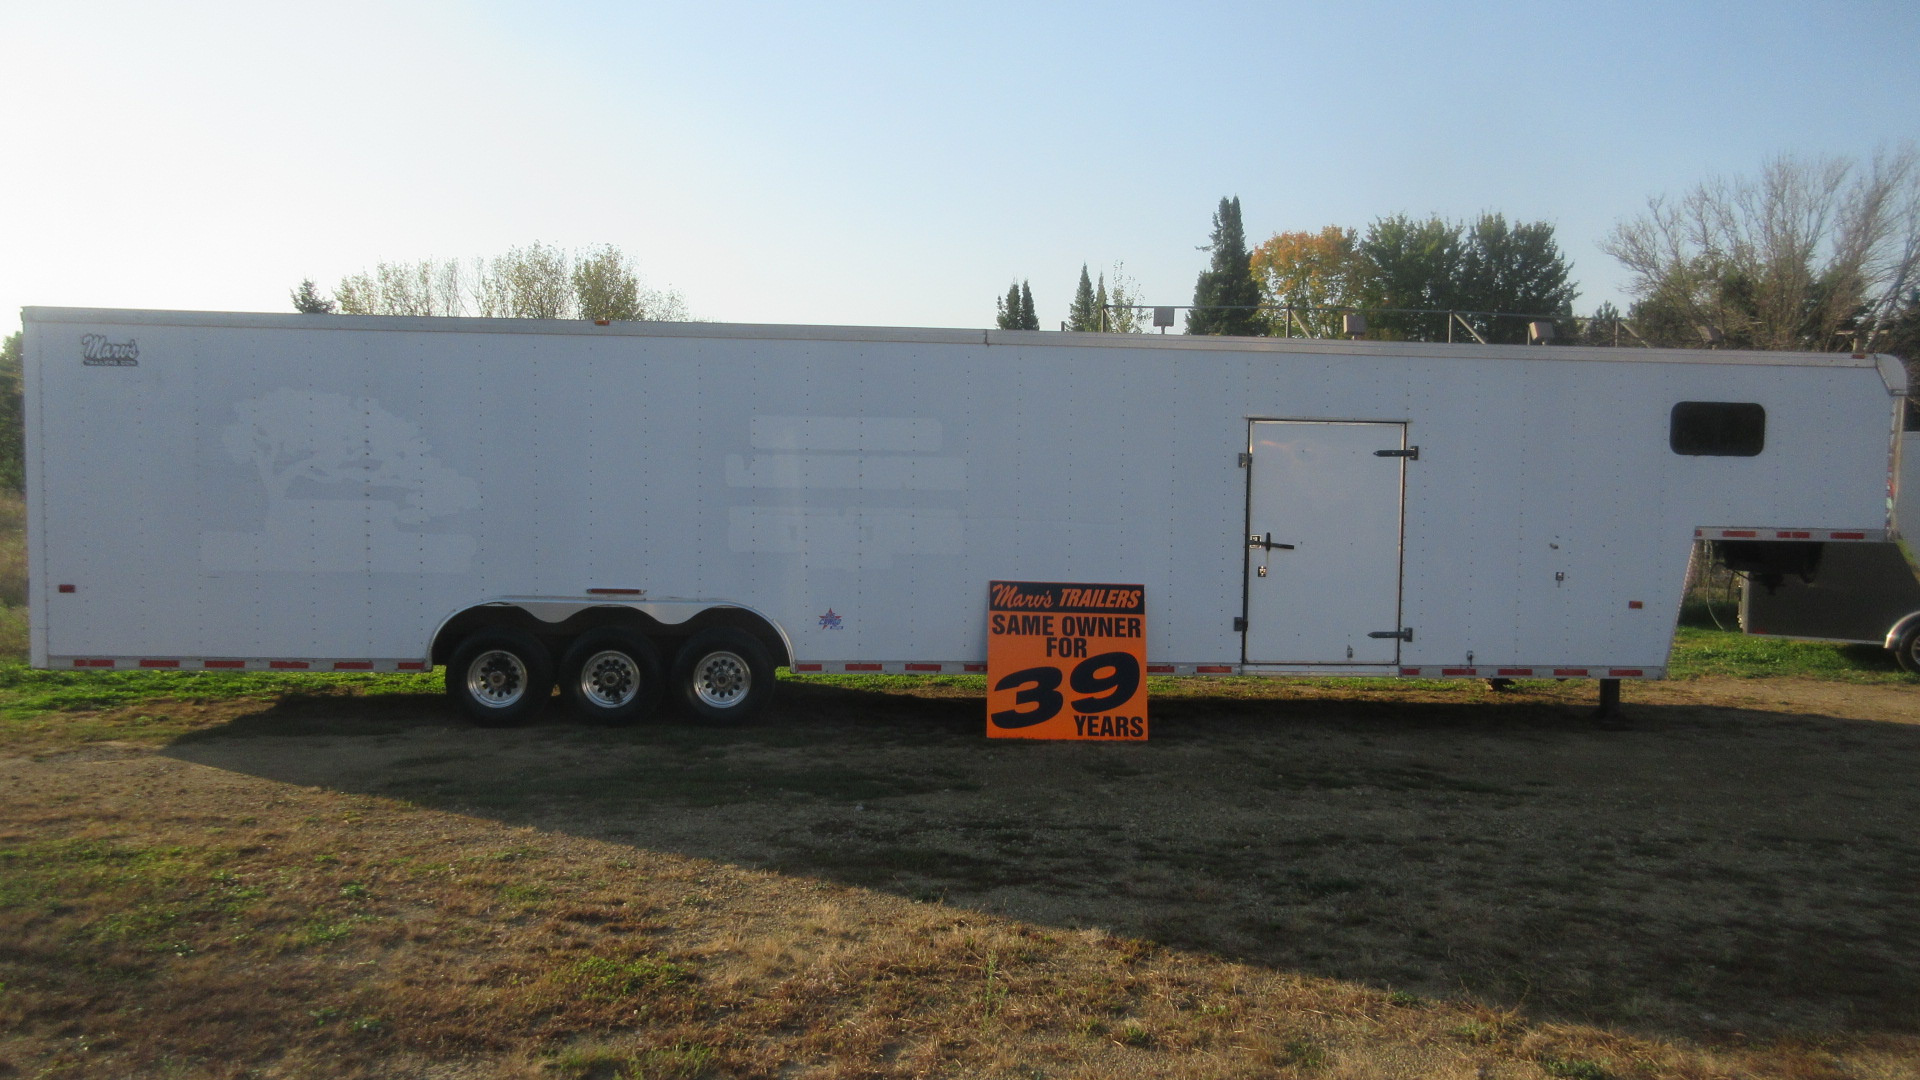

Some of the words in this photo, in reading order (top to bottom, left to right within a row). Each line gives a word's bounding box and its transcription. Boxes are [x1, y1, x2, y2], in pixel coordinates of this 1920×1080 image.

[81, 333, 139, 359] Marv's
[992, 584, 1054, 609] Marv's
[1059, 588, 1141, 609] TRAILERS
[992, 614, 1054, 636] SAME
[1062, 616, 1141, 638] OWNER
[1046, 637, 1087, 658] FOR
[991, 651, 1140, 729] 39
[1074, 715, 1144, 737] YEARS
